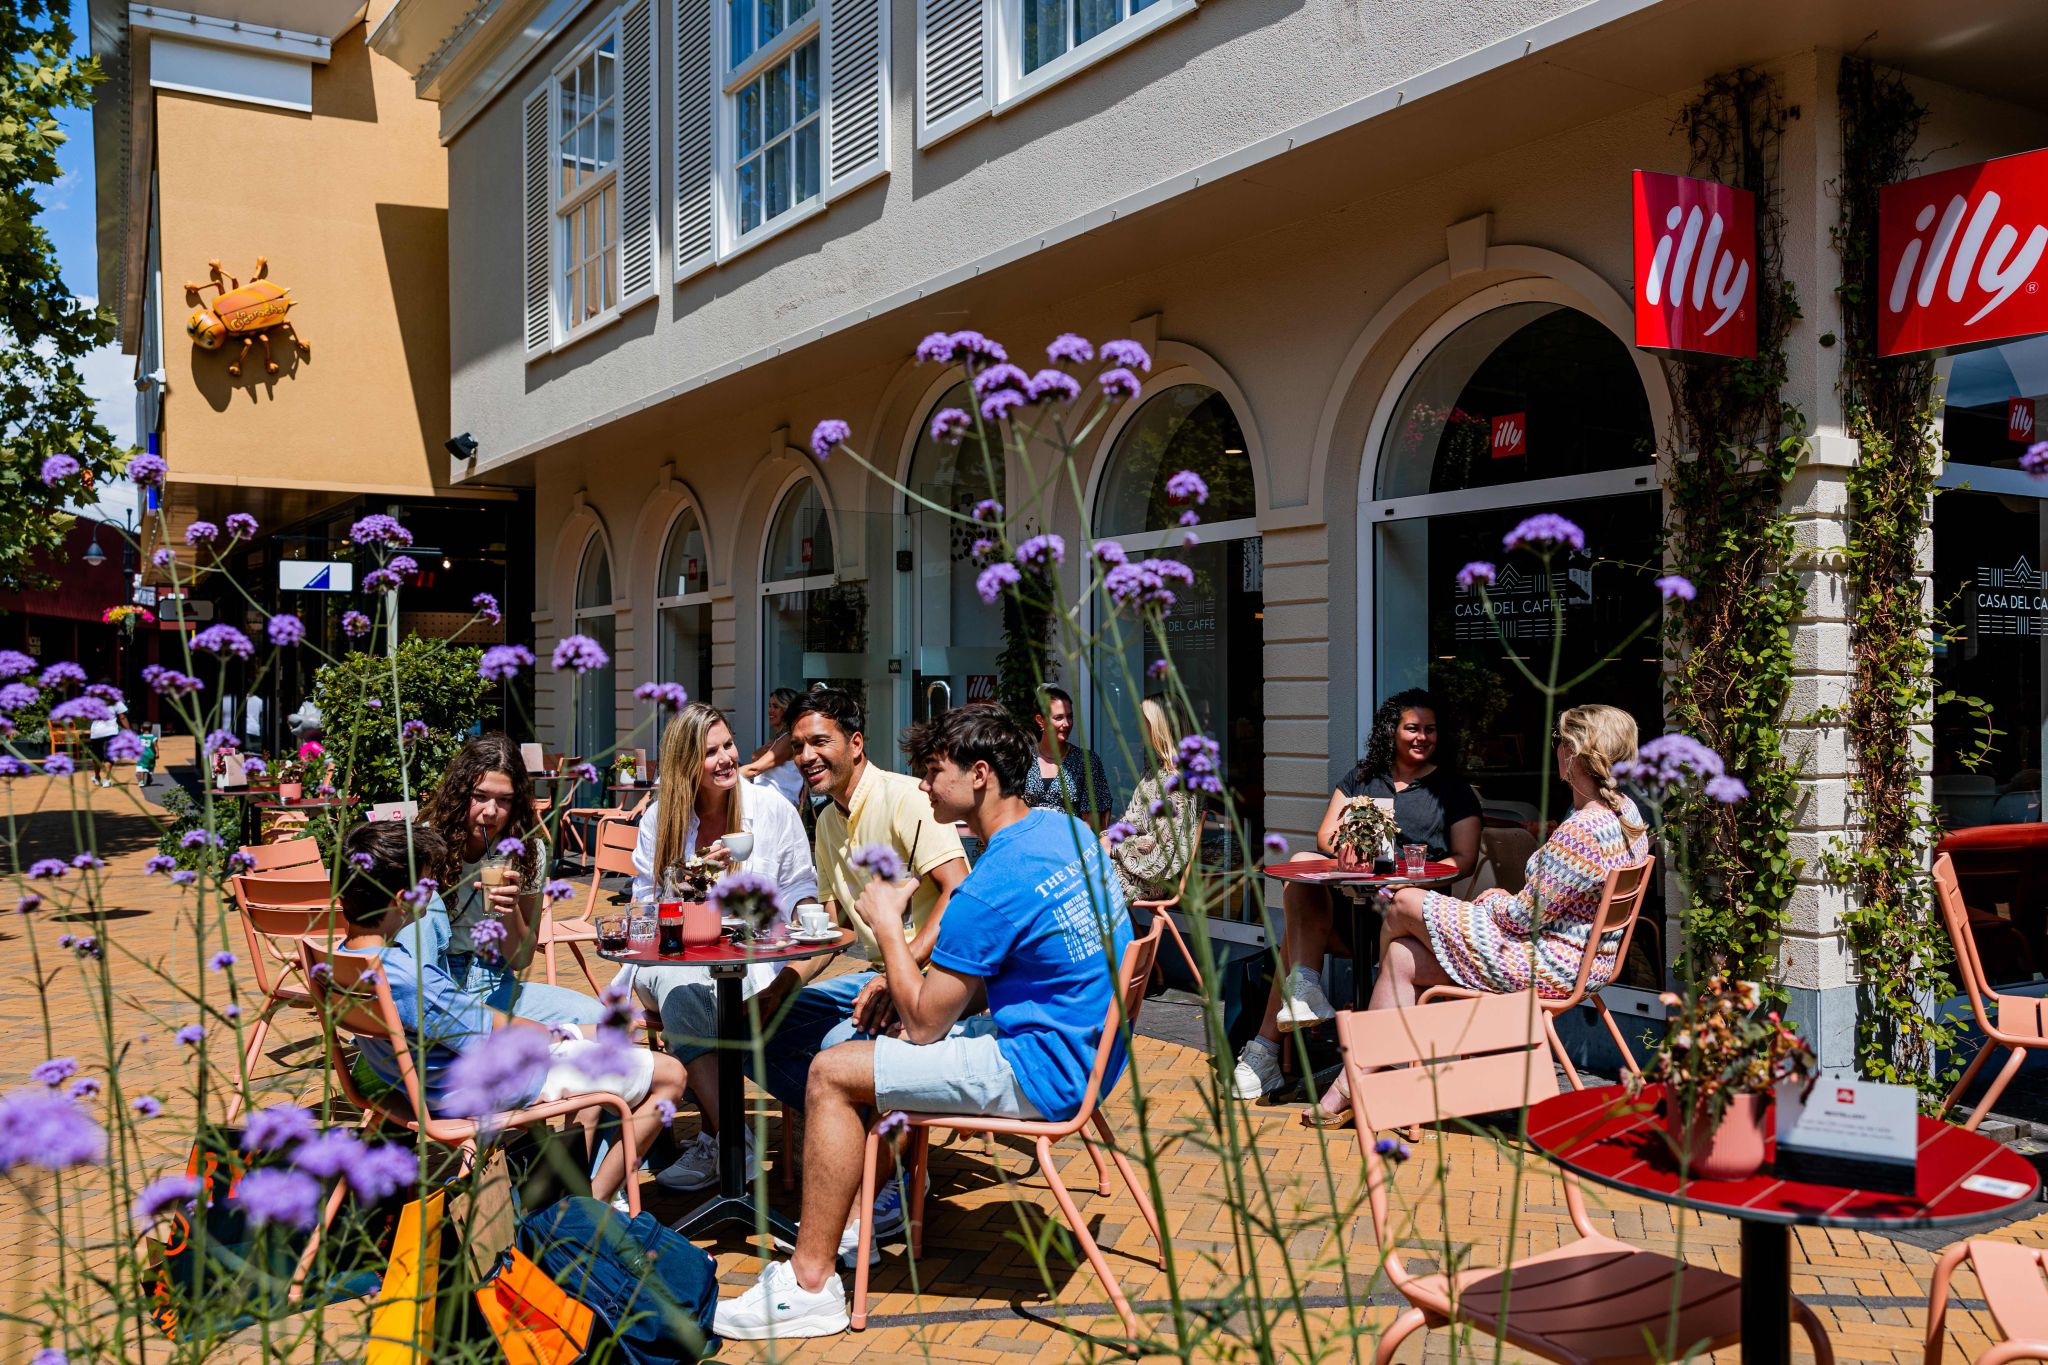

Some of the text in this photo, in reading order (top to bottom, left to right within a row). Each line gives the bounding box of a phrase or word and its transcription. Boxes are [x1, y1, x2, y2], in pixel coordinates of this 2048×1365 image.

[1645, 204, 1750, 337] illy
[1889, 190, 2048, 326] illy
[1494, 420, 1522, 451] illy
[2011, 404, 2033, 437] illy
[1455, 593, 1567, 617] CASA DEL CAFFÈ
[1978, 593, 2008, 609] CASA
[2010, 595, 2031, 610] DEL
[1168, 620, 1185, 632] DEL
[1034, 869, 1068, 899] THE
